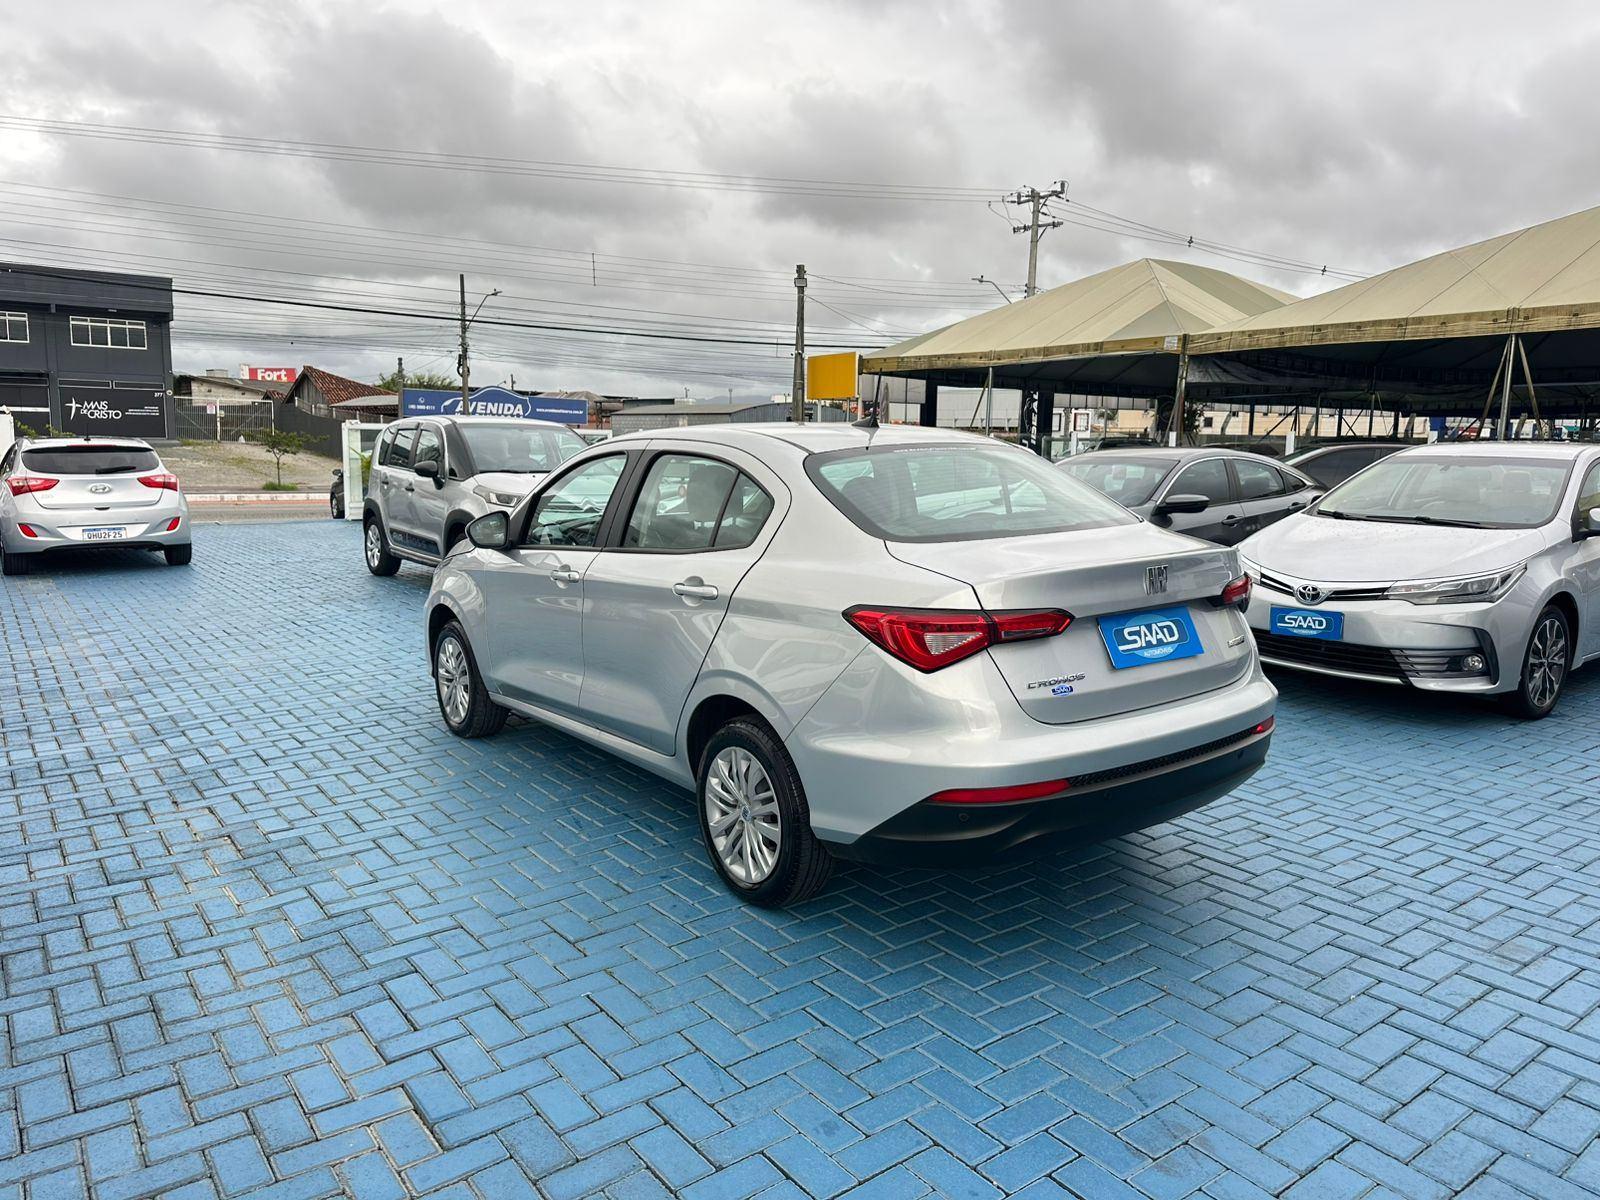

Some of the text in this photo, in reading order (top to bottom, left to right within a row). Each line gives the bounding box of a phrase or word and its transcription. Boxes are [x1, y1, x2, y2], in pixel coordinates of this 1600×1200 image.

[257, 369, 288, 382] Fort
[83, 401, 109, 410] MAIS
[455, 401, 523, 416] AVENIDA
[87, 410, 122, 419] CRISTO
[1277, 615, 1326, 629] SAAD
[1119, 621, 1179, 650] SAAD
[1027, 672, 1085, 689] CRONOS
